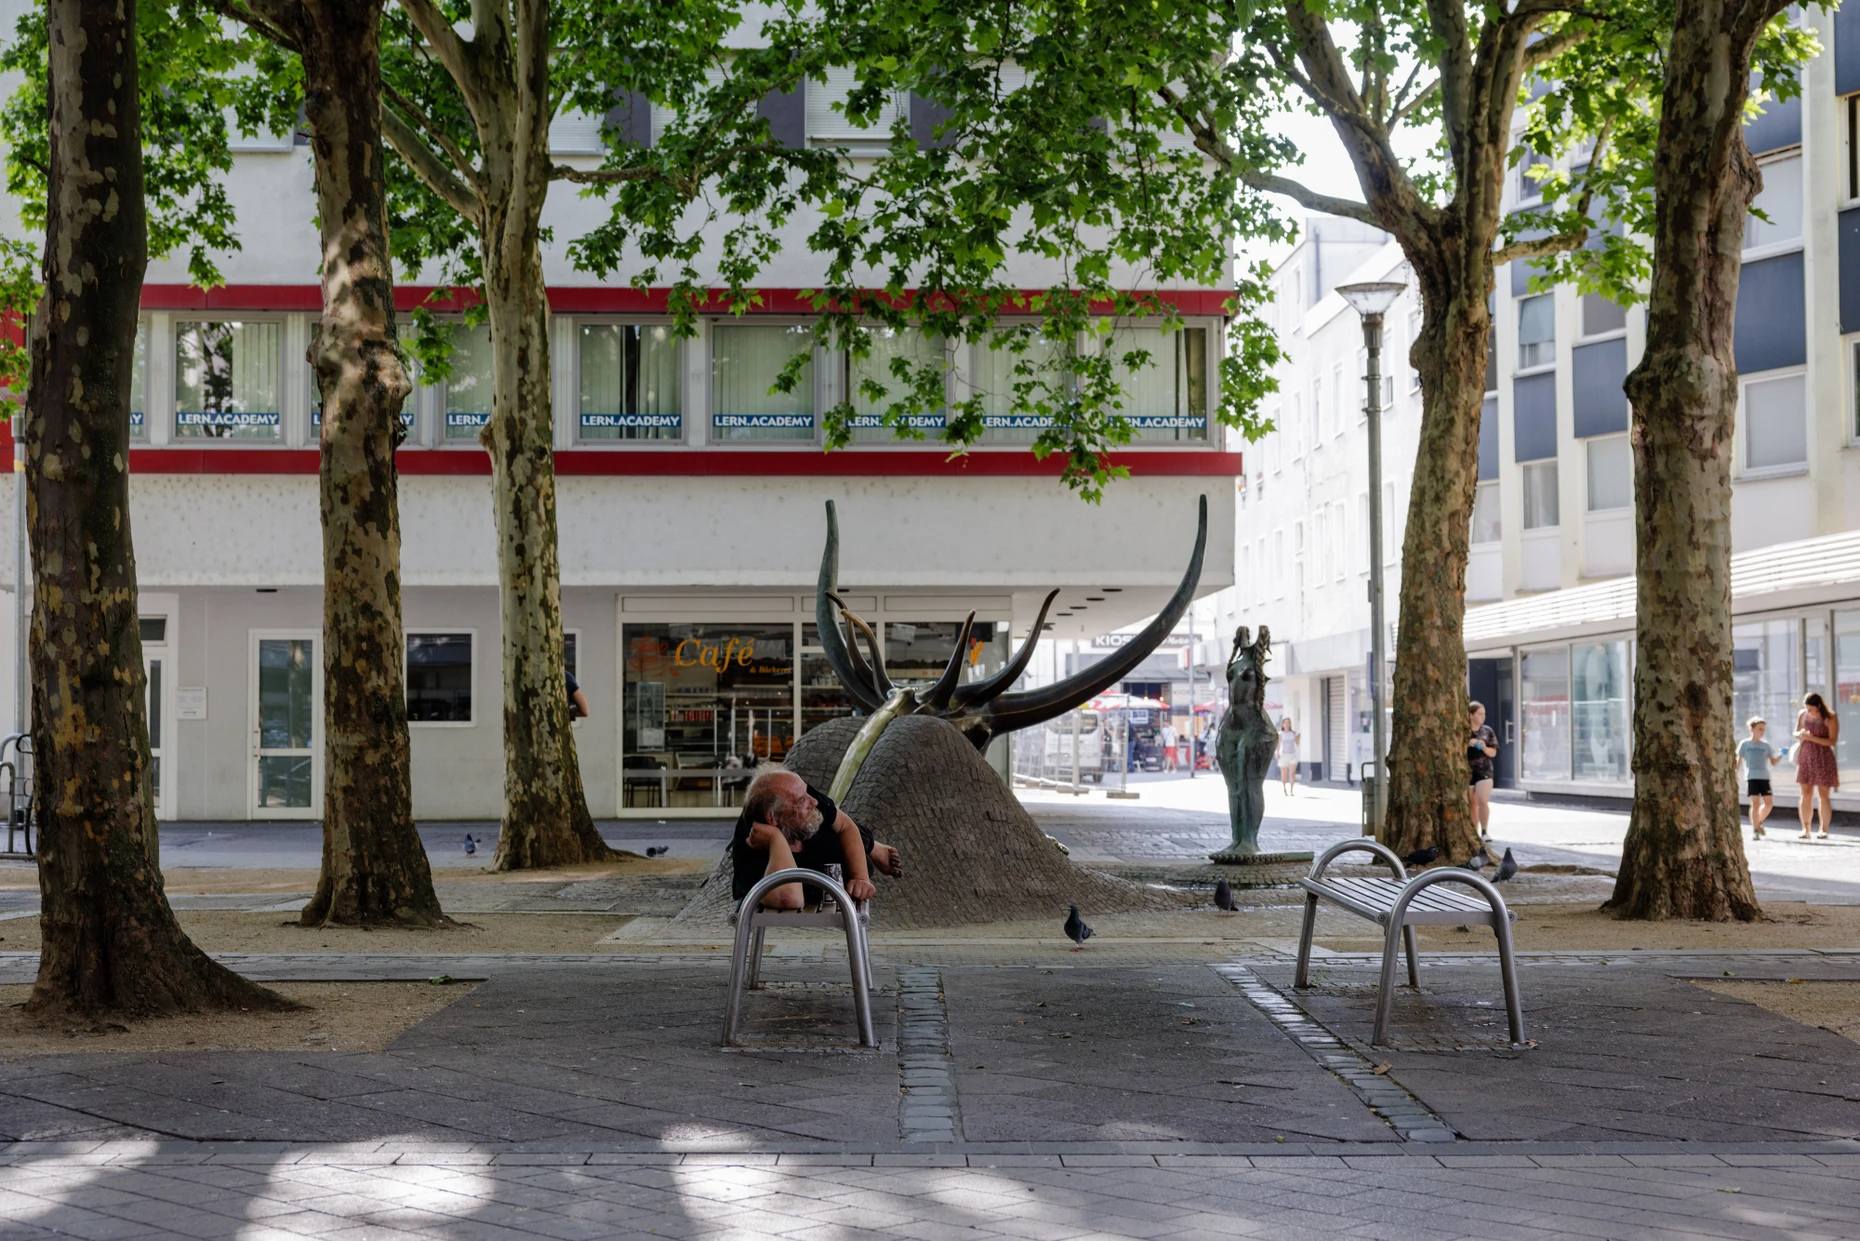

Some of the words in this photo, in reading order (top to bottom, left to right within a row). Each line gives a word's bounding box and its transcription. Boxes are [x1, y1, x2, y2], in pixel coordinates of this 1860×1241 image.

[178, 413, 278, 425] LERN.ACADEMY
[582, 415, 680, 426] LERN.ACADEMY
[714, 416, 812, 427] LERN.ACADEMY
[1095, 634, 1137, 646] KIOS
[675, 637, 756, 673] Café
